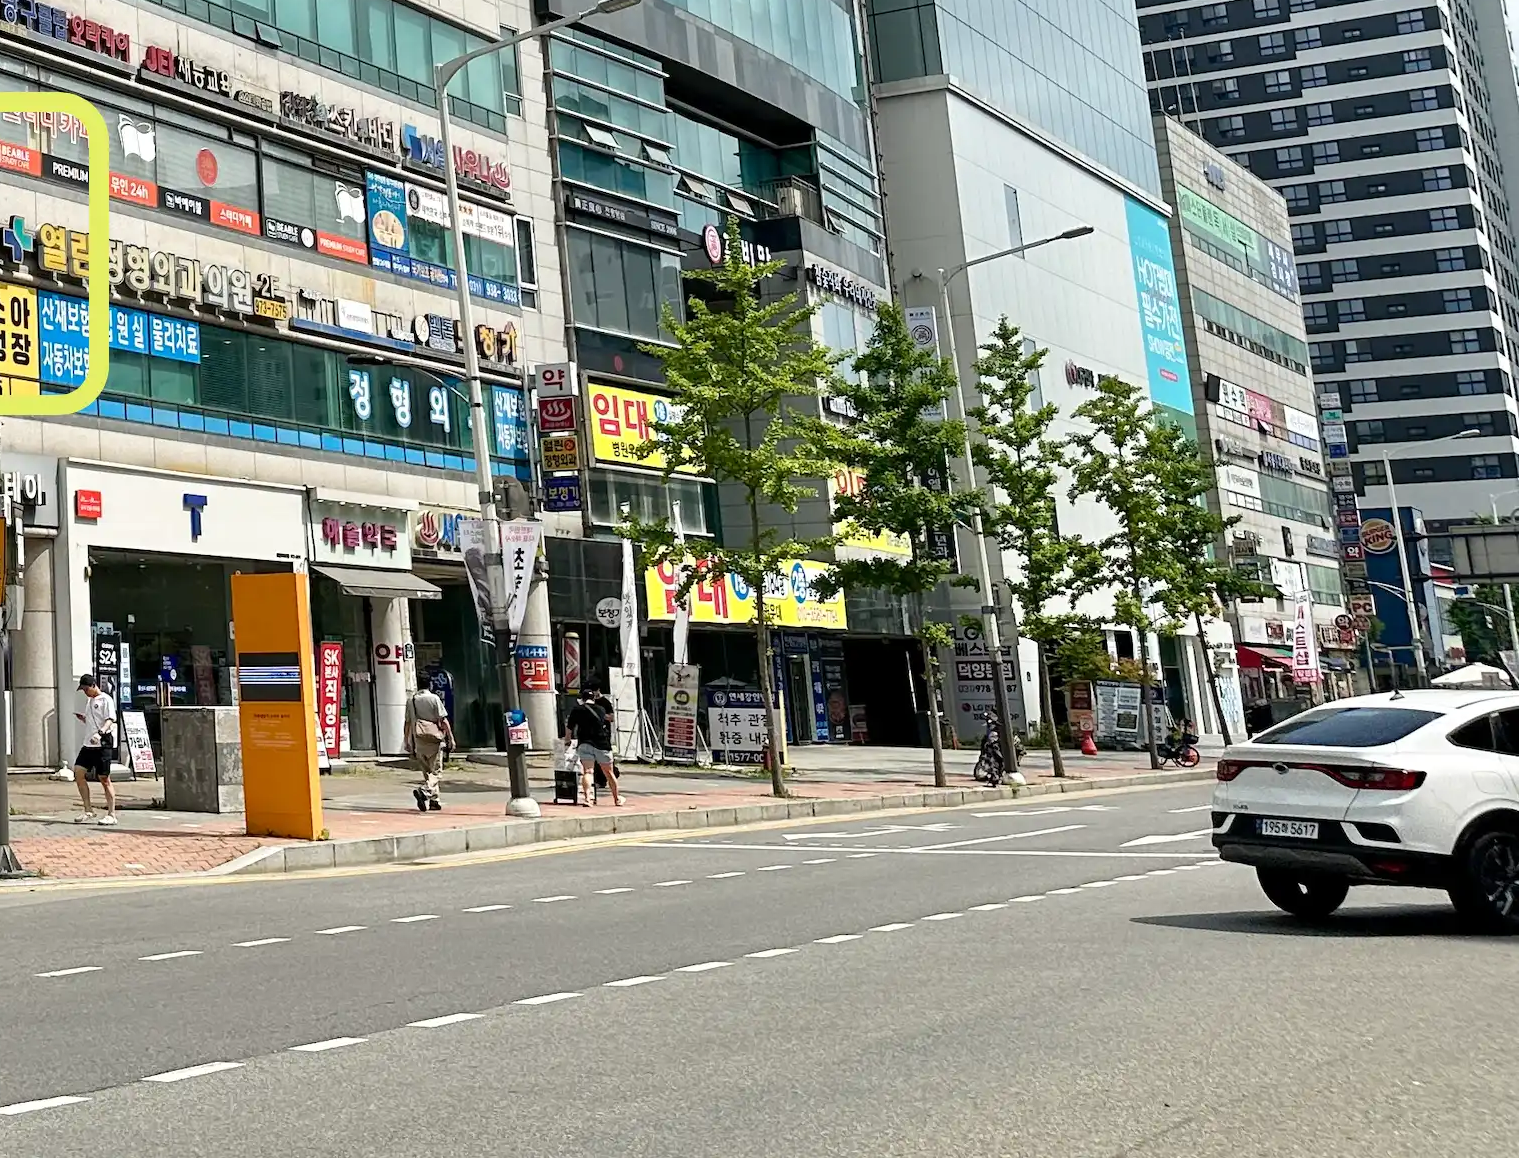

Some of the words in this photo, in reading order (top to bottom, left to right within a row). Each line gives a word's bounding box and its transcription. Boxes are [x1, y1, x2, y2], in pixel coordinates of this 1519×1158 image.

[144, 45, 174, 78] JEI
[178, 56, 233, 94] 재능교육
[2, 146, 30, 162] BEABLE
[52, 162, 89, 183] PREMIUM
[110, 176, 129, 196] 무인
[130, 183, 148, 200] 24h
[219, 208, 252, 229] 스터디카페
[257, 273, 279, 299] 2F
[254, 298, 287, 320] 973-7575
[152, 318, 198, 356] 물리치료
[542, 369, 565, 391] 약
[593, 393, 649, 441] 임대
[543, 440, 564, 453] 열린
[544, 454, 578, 468] 정형외과
[548, 486, 580, 501] 보청기
[183, 494, 208, 536] T
[322, 517, 398, 549] 예솔약국
[1361, 525, 1390, 538] BURGER
[1363, 530, 1395, 546] KING
[1347, 545, 1360, 559] 약
[1353, 602, 1373, 613] PC
[99, 650, 117, 665] S24
[324, 649, 339, 666] SK
[376, 643, 403, 673] 약
[521, 660, 549, 677] 입구
[324, 679, 339, 749] 직영점
[718, 713, 741, 726] 척추
[1290, 822, 1315, 836] 5617
